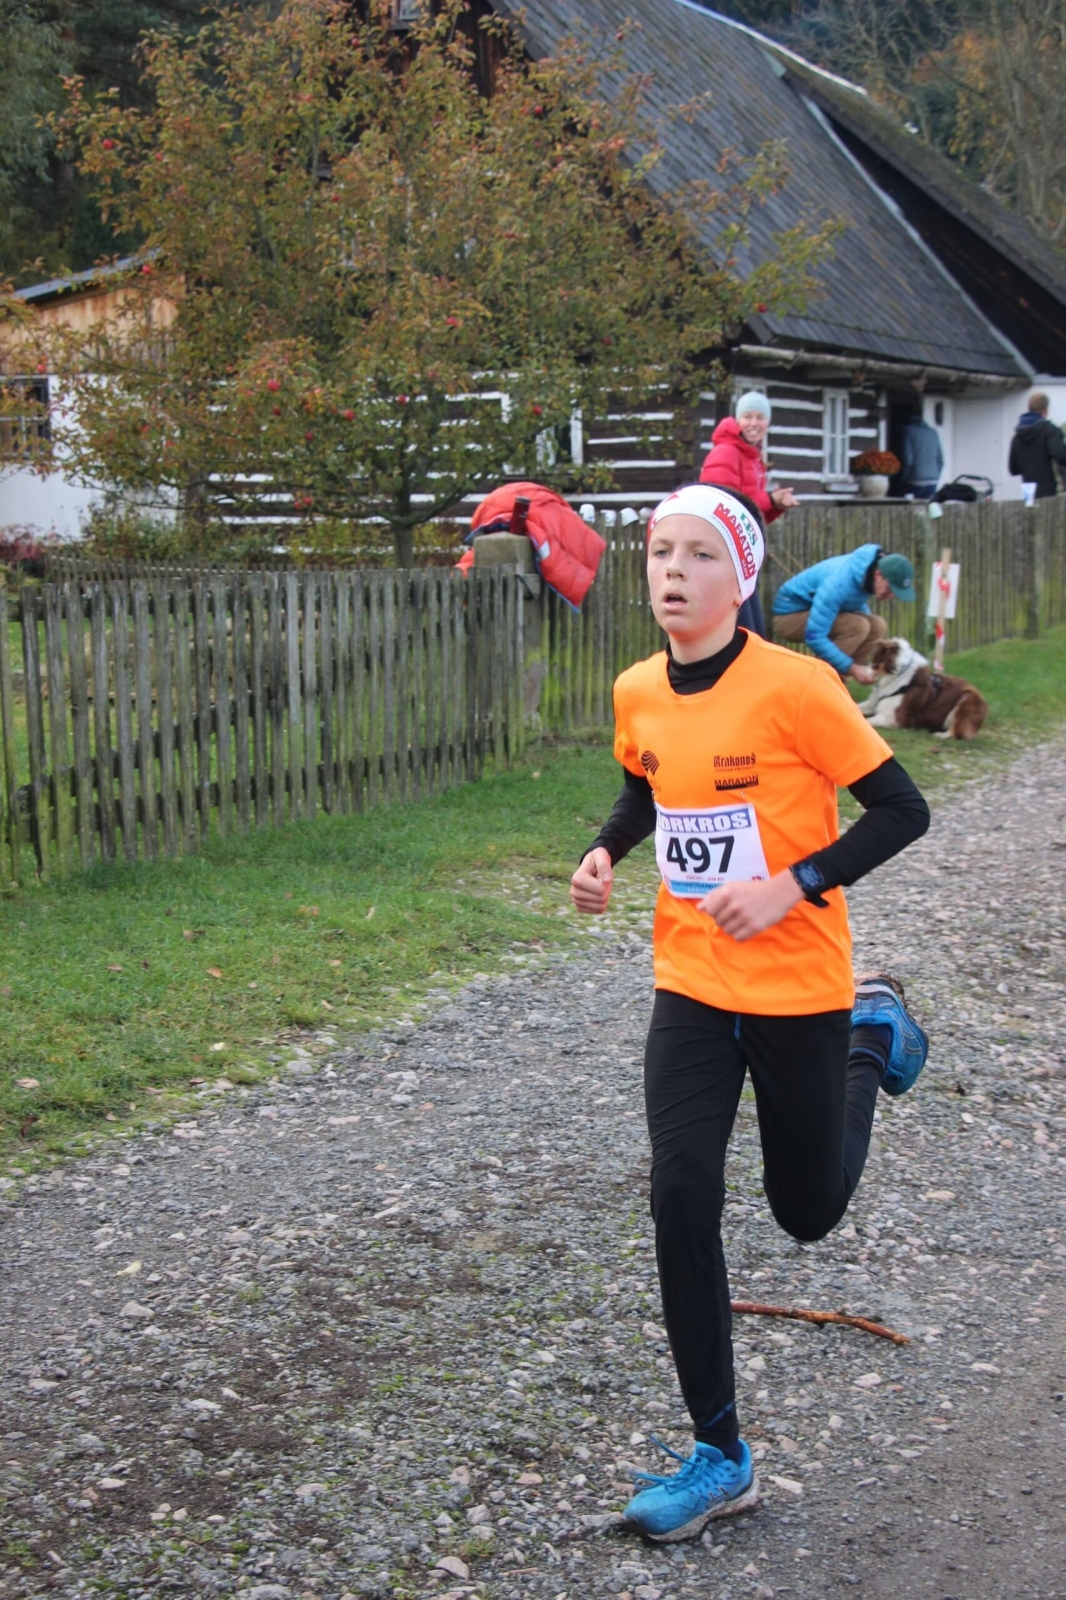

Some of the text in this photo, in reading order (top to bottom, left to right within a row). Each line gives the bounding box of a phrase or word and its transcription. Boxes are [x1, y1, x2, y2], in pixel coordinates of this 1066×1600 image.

[715, 502, 757, 577] MARATON
[714, 774, 759, 788] MARATON
[666, 835, 735, 873] 497
